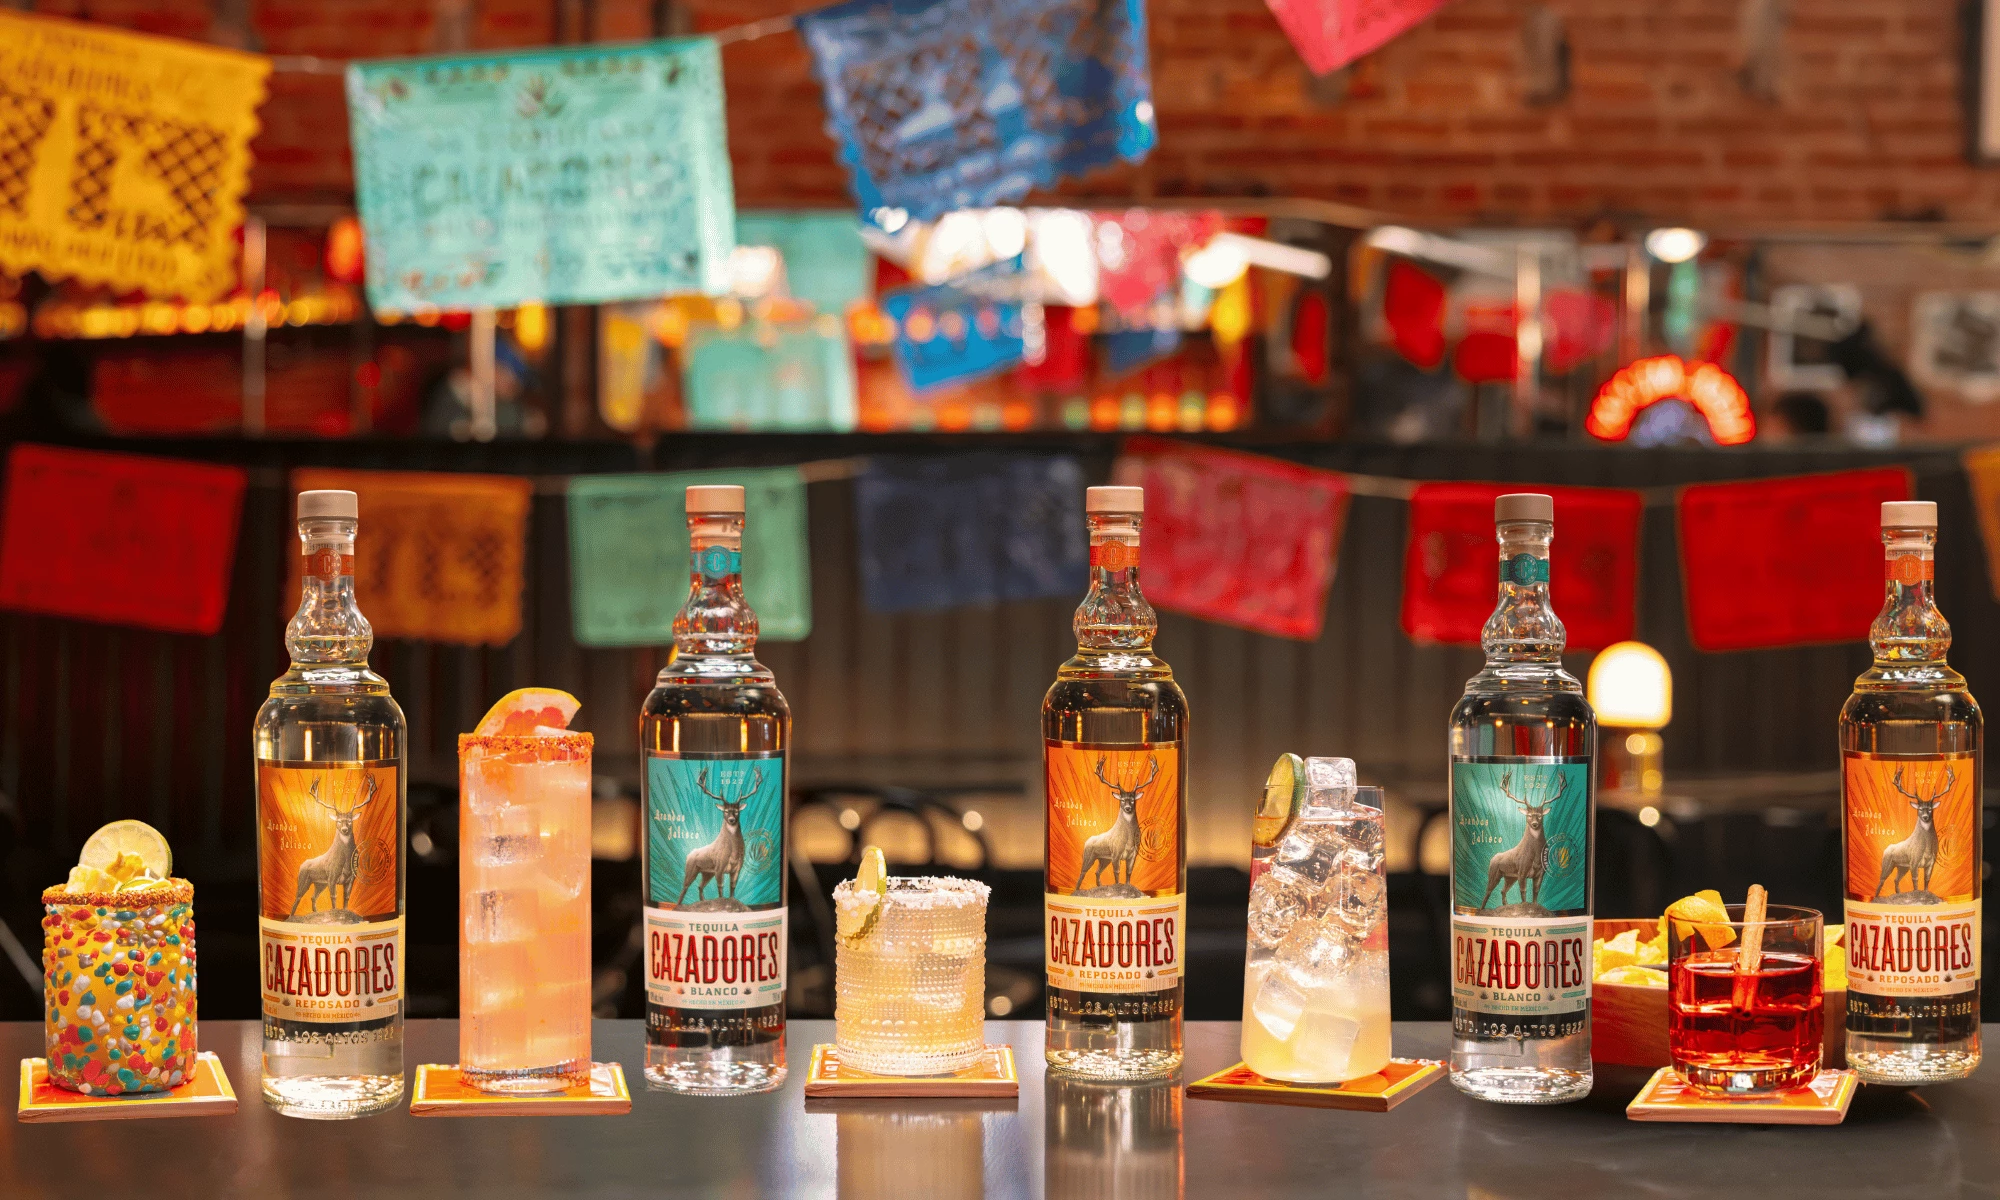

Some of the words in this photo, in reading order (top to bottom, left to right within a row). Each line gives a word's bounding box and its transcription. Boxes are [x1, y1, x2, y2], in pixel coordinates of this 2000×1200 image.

[1066, 813, 1097, 828] Jalisco
[667, 826, 699, 840] Jalisco
[1865, 823, 1896, 837] Jalisco
[280, 836, 312, 850] Jalisco
[1471, 831, 1503, 845] Jalisco
[1085, 908, 1134, 919] TEQUILA
[1884, 915, 1932, 925] TEQUILA
[689, 923, 739, 934] TEQUILA
[1491, 927, 1542, 938] TEQUILA
[301, 935, 352, 946] TEQUILA
[1050, 915, 1174, 968] CAZADORES
[1851, 922, 1971, 972] CAZADORES
[651, 931, 778, 984] CAZADORES
[1457, 936, 1583, 989] CAZADORES
[265, 942, 394, 997] CAZADORES
[1079, 970, 1141, 980] REPOSADO
[1879, 975, 1939, 984] REPOSADO
[690, 987, 738, 996] BLANCO
[1493, 992, 1541, 1002] BLANCO
[295, 999, 360, 1009] REPOSADO
[1079, 1001, 1101, 1014] LOS
[1107, 1002, 1148, 1015] ALTOS
[711, 1017, 753, 1031] ALTOS
[757, 1014, 778, 1028] 1922
[1483, 1022, 1508, 1037] LOS
[1513, 1024, 1556, 1037] ALTOS
[1560, 1021, 1583, 1036] 1922
[295, 1030, 320, 1044] LOS
[325, 1029, 369, 1045] ALTOS
[373, 1026, 394, 1042] 1922
